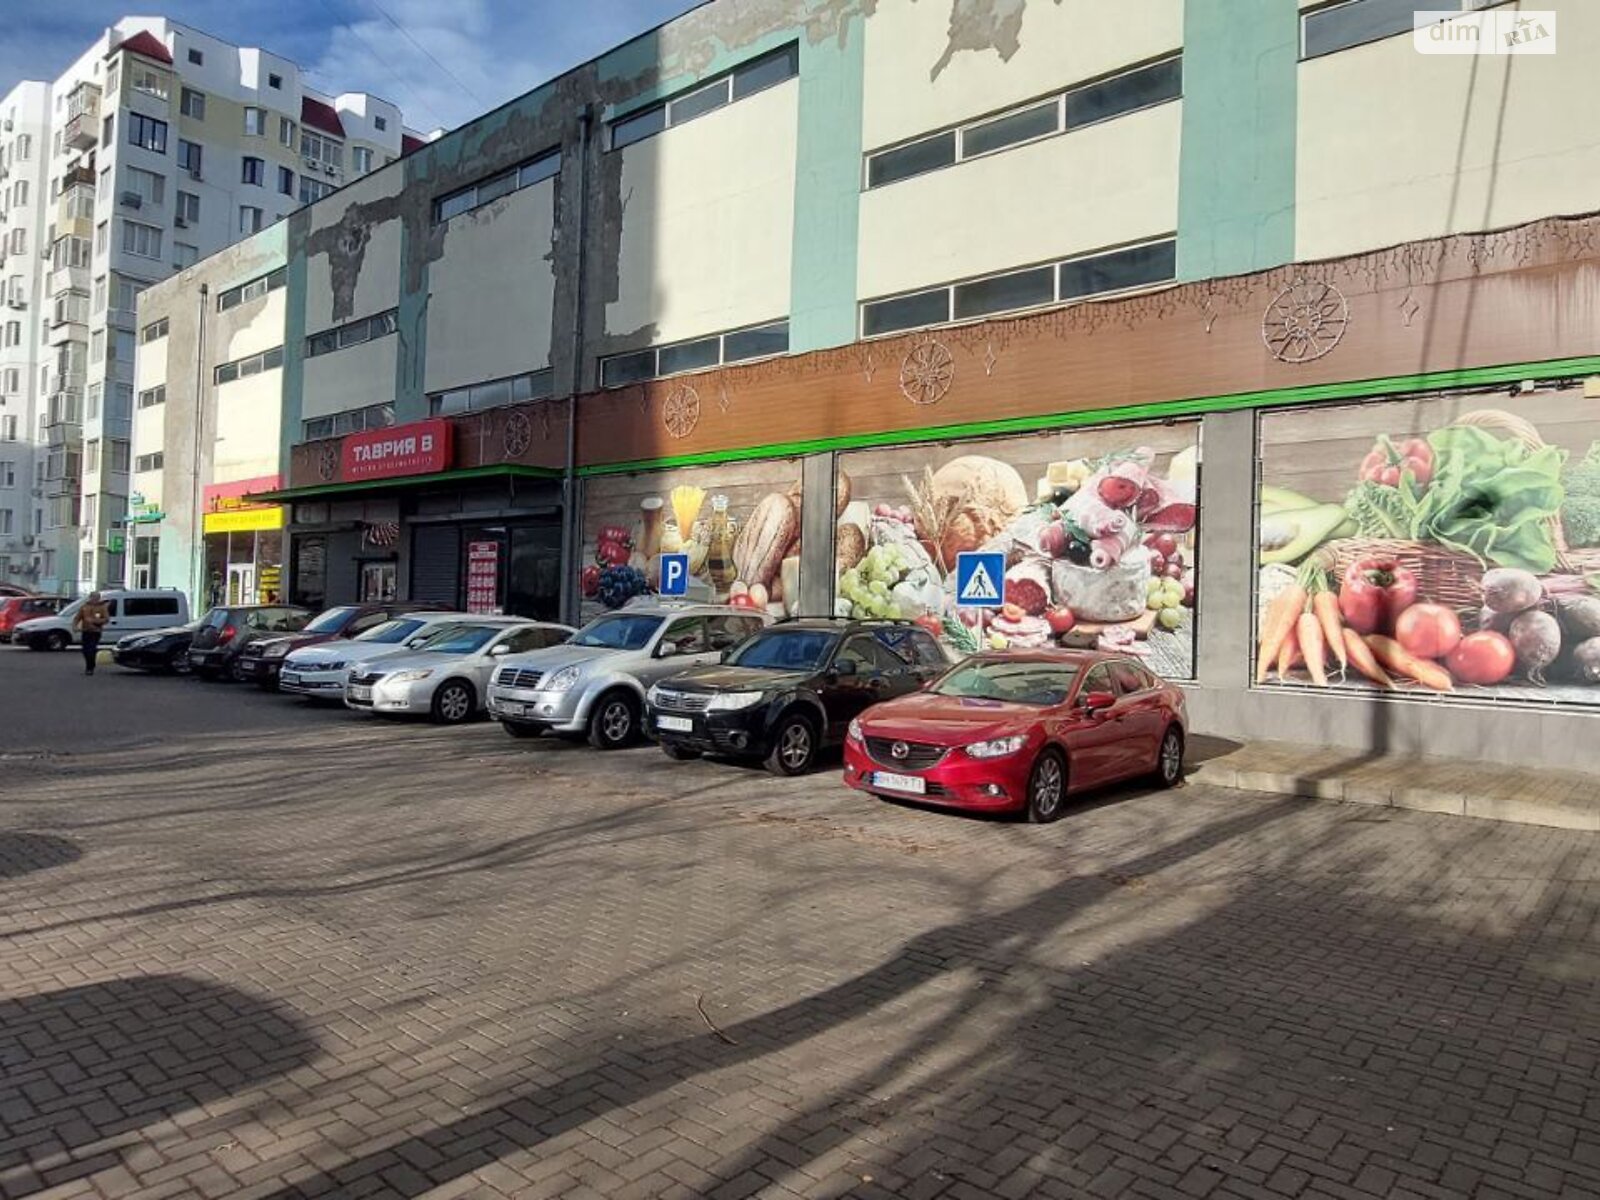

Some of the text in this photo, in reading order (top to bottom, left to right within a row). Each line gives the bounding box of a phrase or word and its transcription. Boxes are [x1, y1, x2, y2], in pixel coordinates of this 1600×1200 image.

[353, 434, 433, 462] ТАВРИЯ В
[667, 560, 682, 589] P
